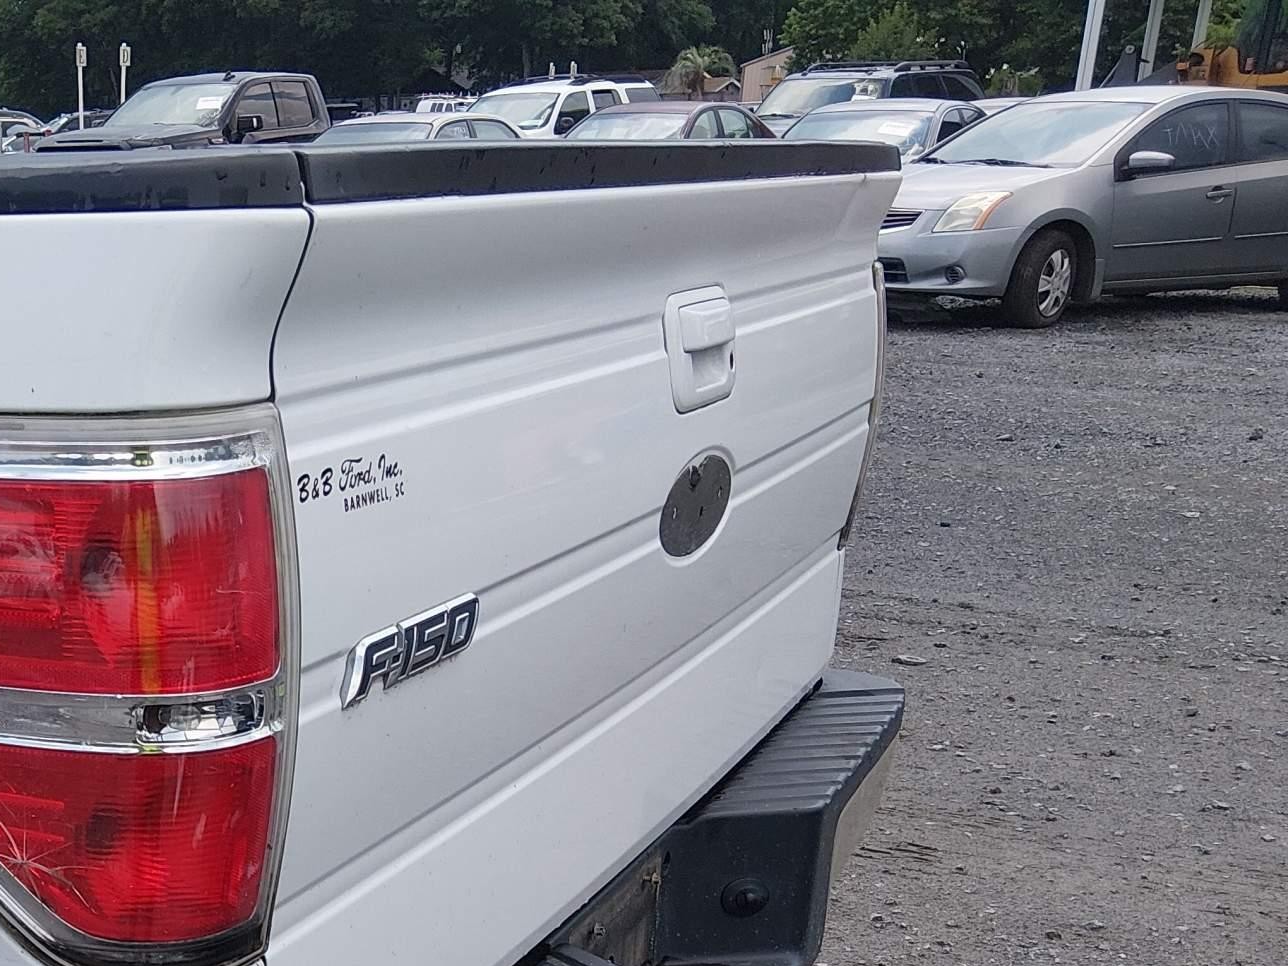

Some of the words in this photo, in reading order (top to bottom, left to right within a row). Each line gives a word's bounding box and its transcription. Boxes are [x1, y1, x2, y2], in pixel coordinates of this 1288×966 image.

[122, 49, 129, 64] D
[297, 467, 333, 503] B&B
[338, 457, 376, 492] Ford,
[378, 453, 403, 482] Inc.
[343, 488, 392, 512] BARNWELL,
[395, 481, 405, 497] SC
[339, 592, 479, 711] F-150
